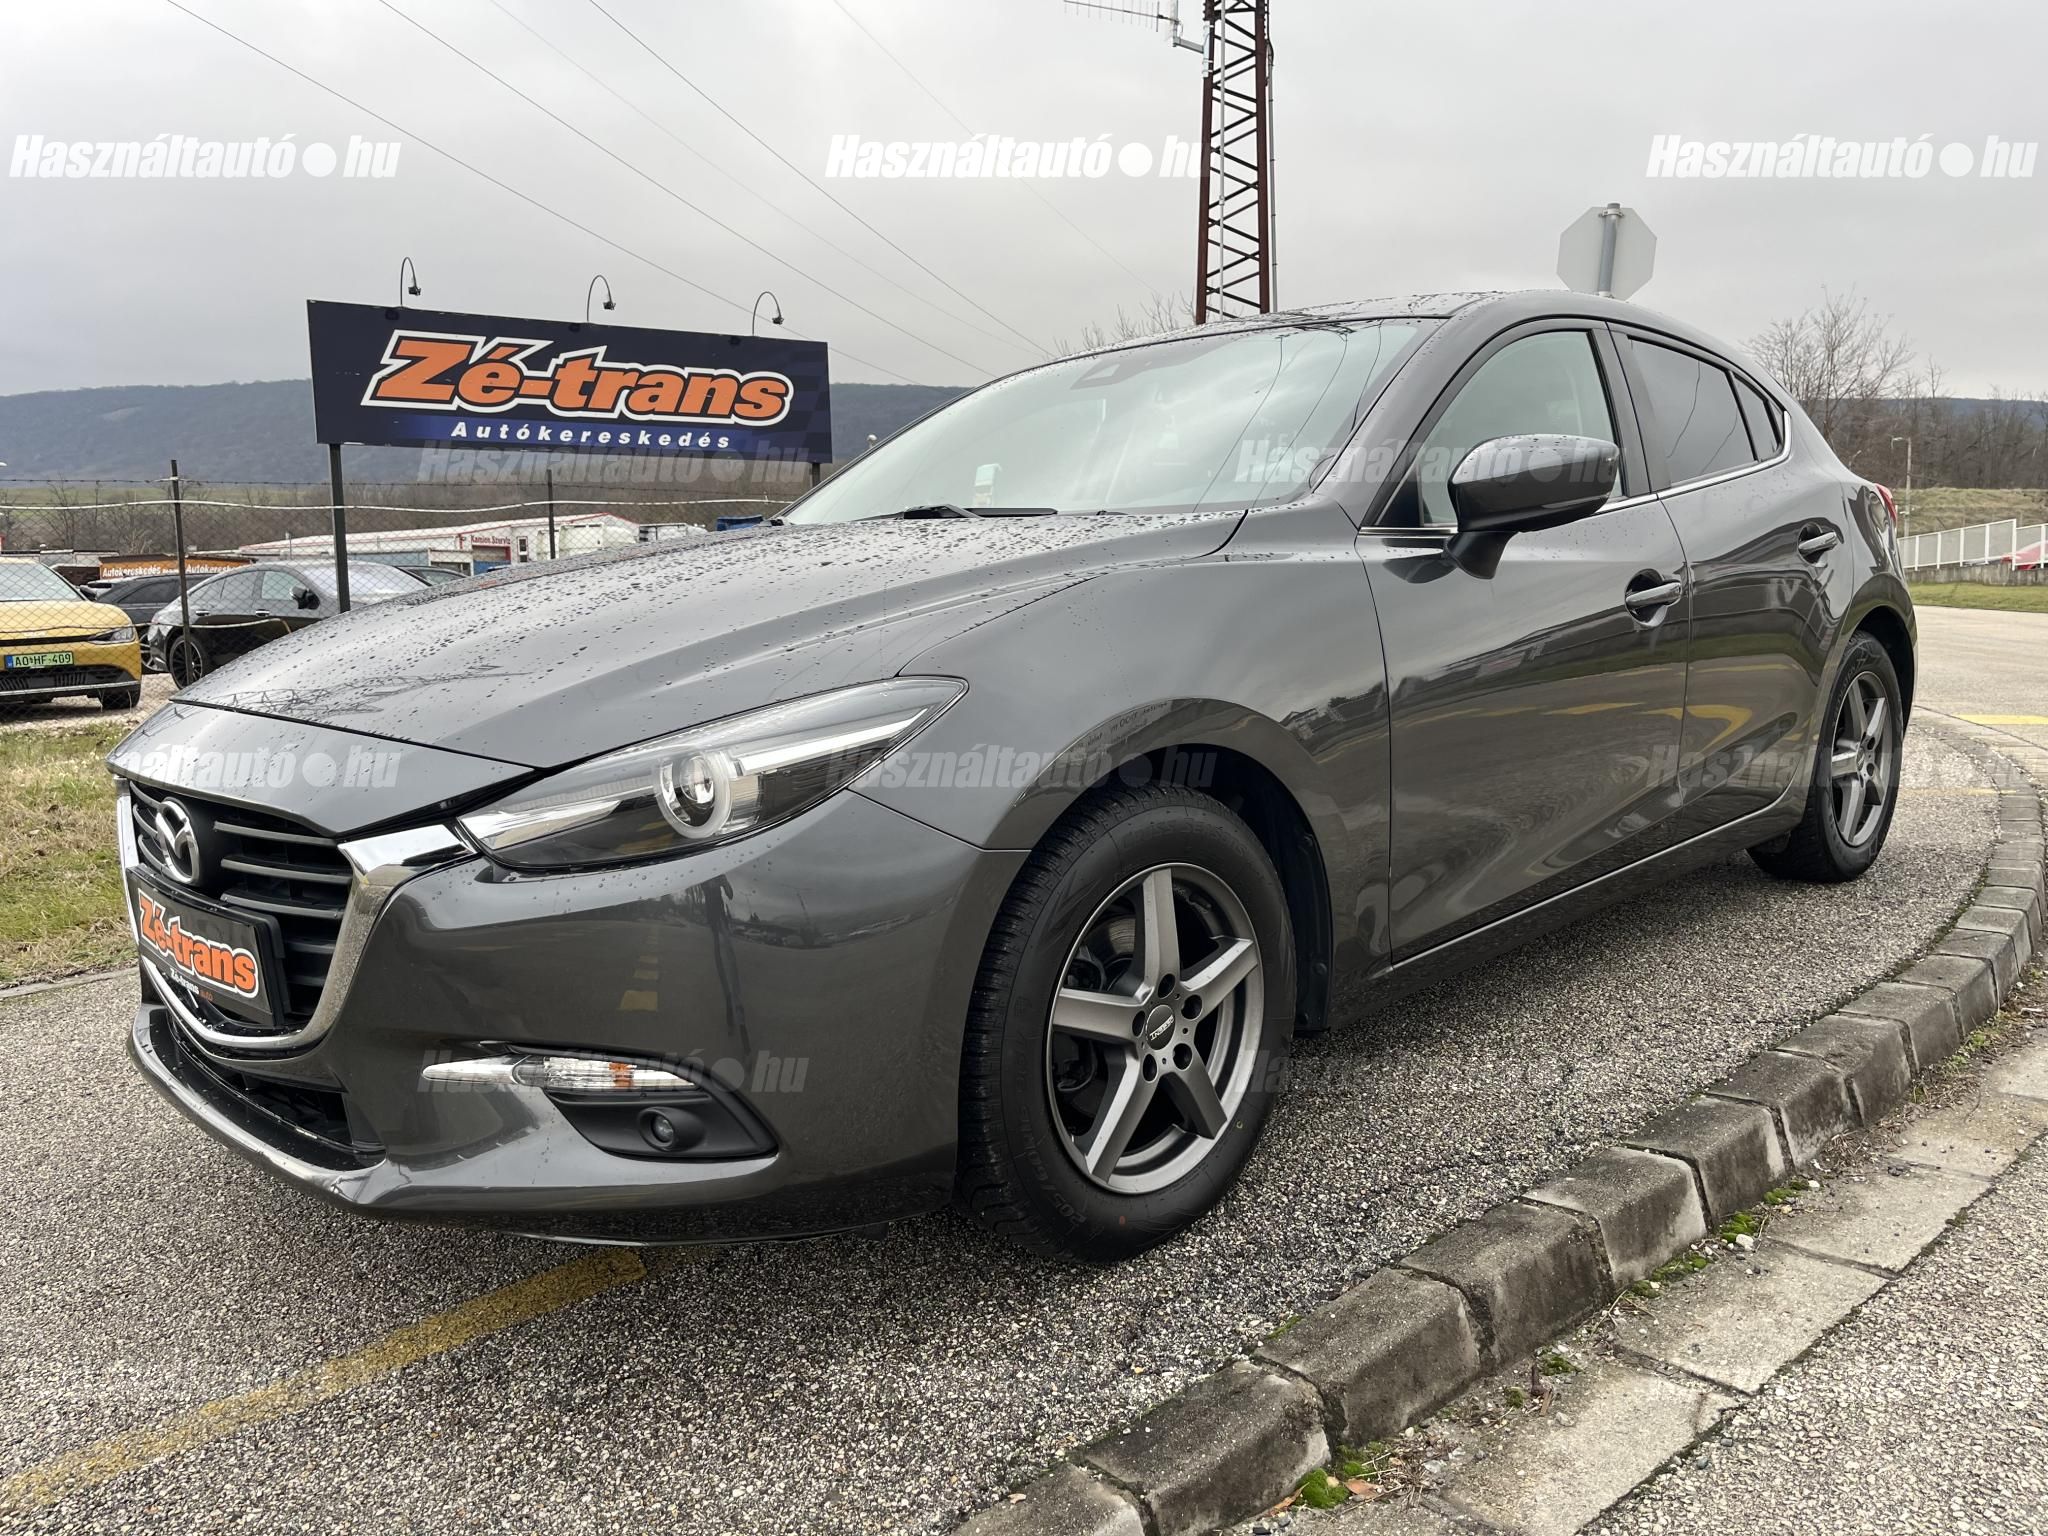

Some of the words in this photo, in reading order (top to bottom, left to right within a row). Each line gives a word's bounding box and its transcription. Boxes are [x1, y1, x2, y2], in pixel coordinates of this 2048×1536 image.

[360, 329, 794, 426] Zé-trans
[451, 421, 730, 448] Autókereskedés
[138, 888, 259, 998] Zé-trans
